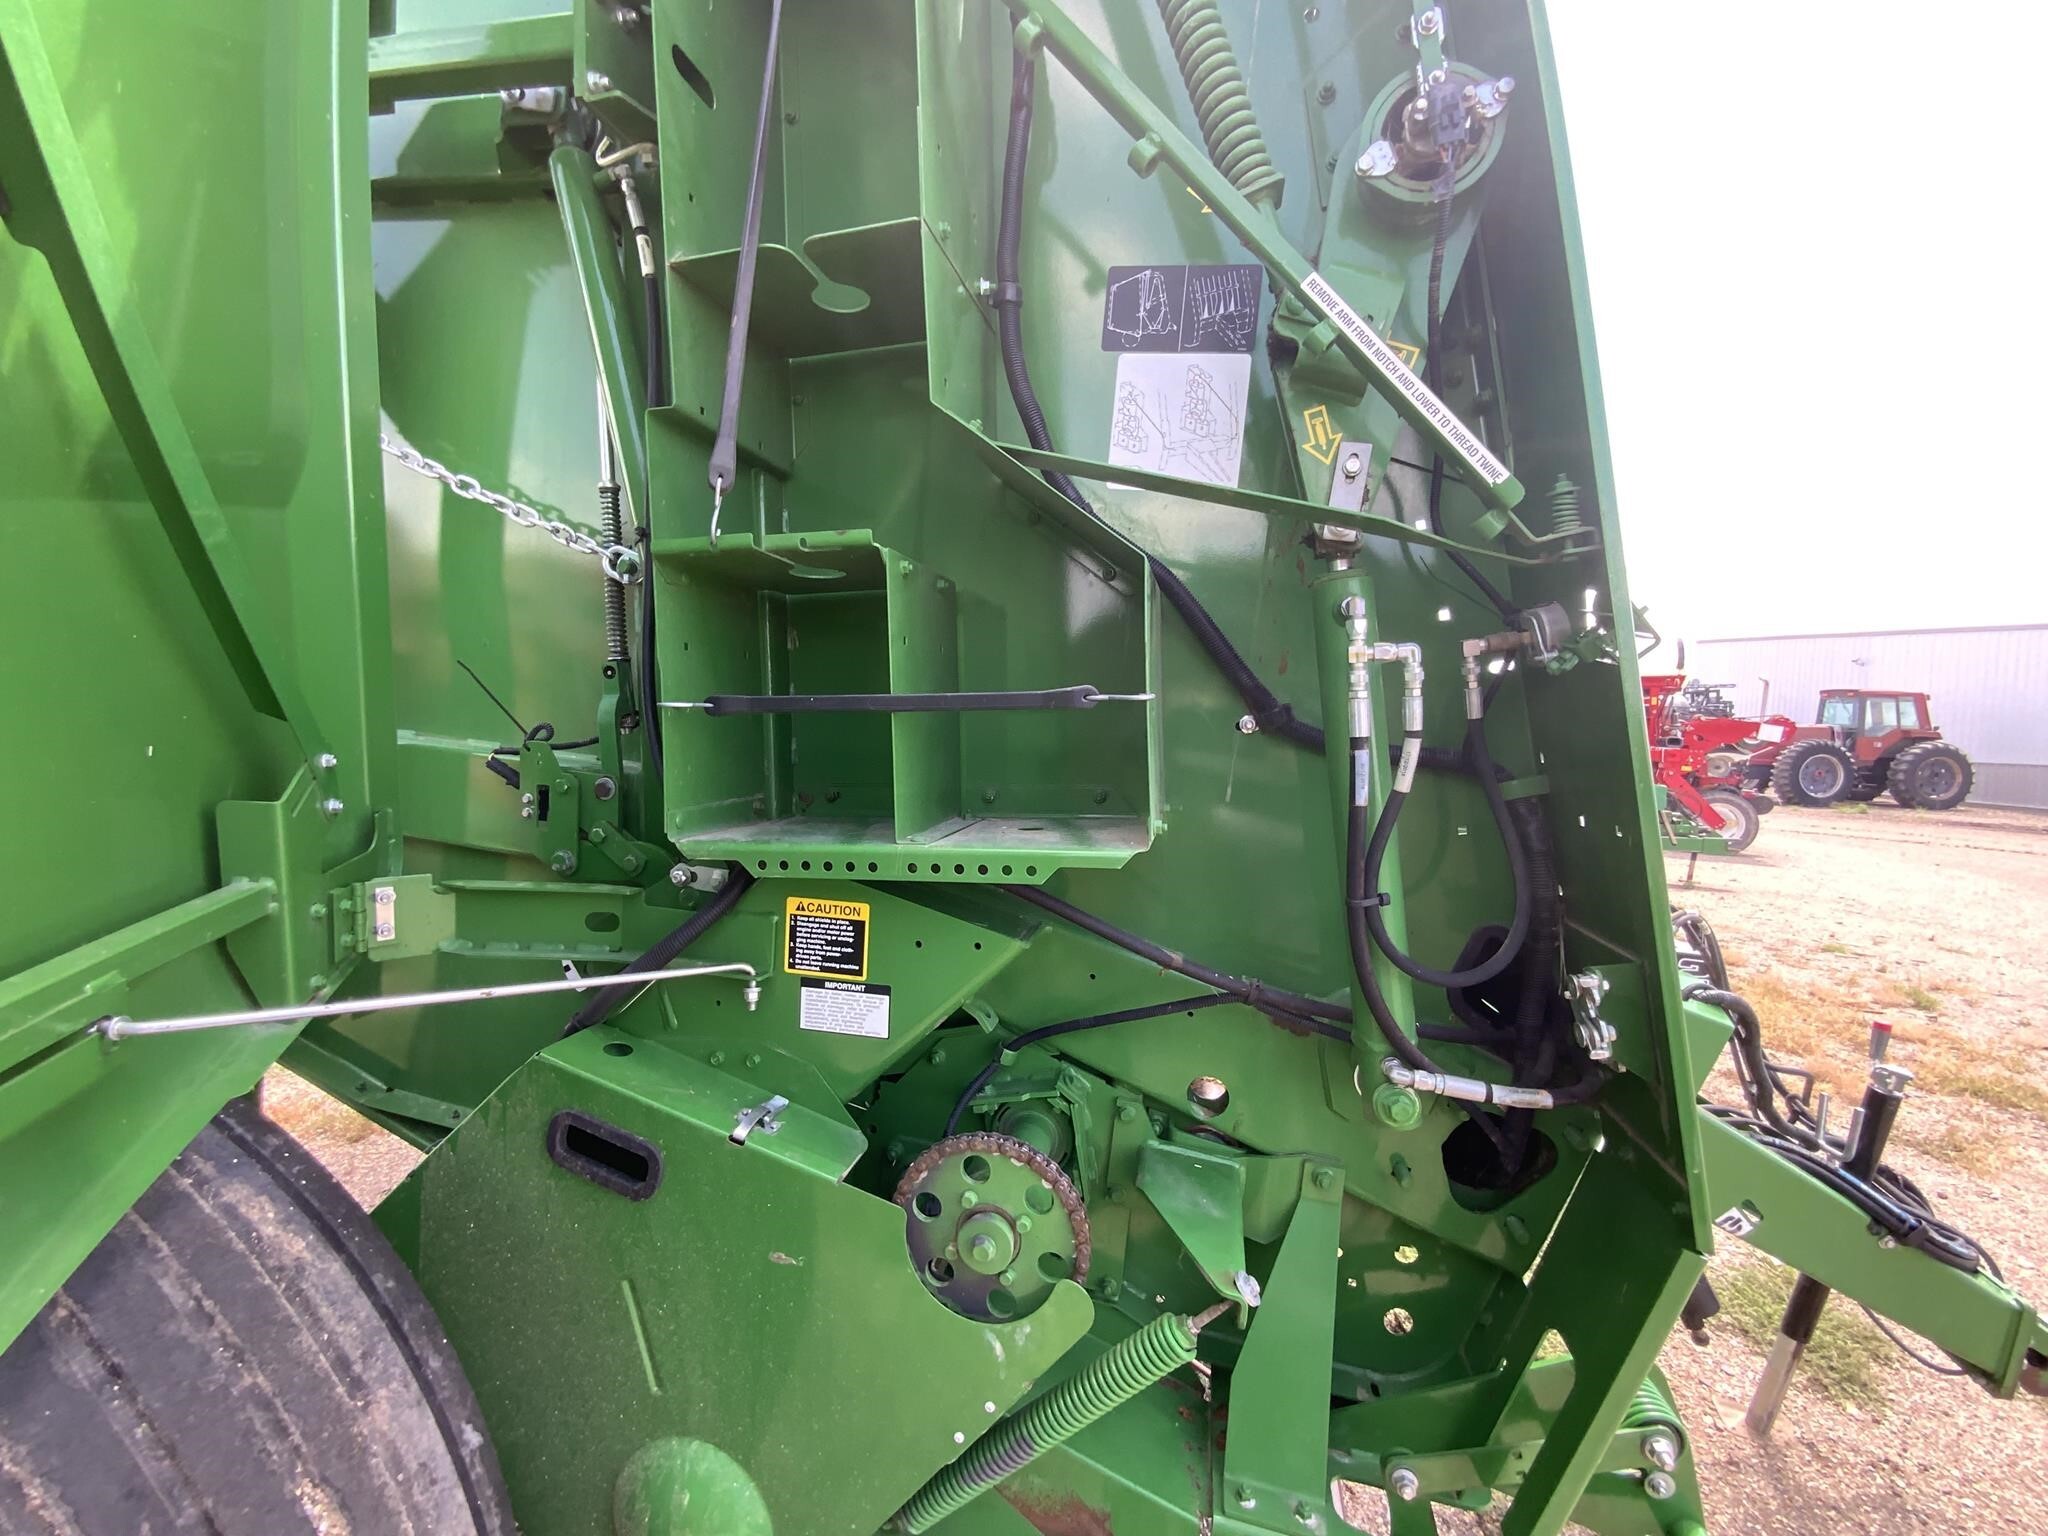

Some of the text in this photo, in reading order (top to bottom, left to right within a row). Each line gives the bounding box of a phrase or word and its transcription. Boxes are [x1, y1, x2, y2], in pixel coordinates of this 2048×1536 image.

[1306, 278, 1504, 482] REMOVE ARM FROM NOTCH AND LOWER TO THREAD TWINE
[807, 903, 860, 916] CAUTION
[825, 982, 865, 991] IMPORTANT
